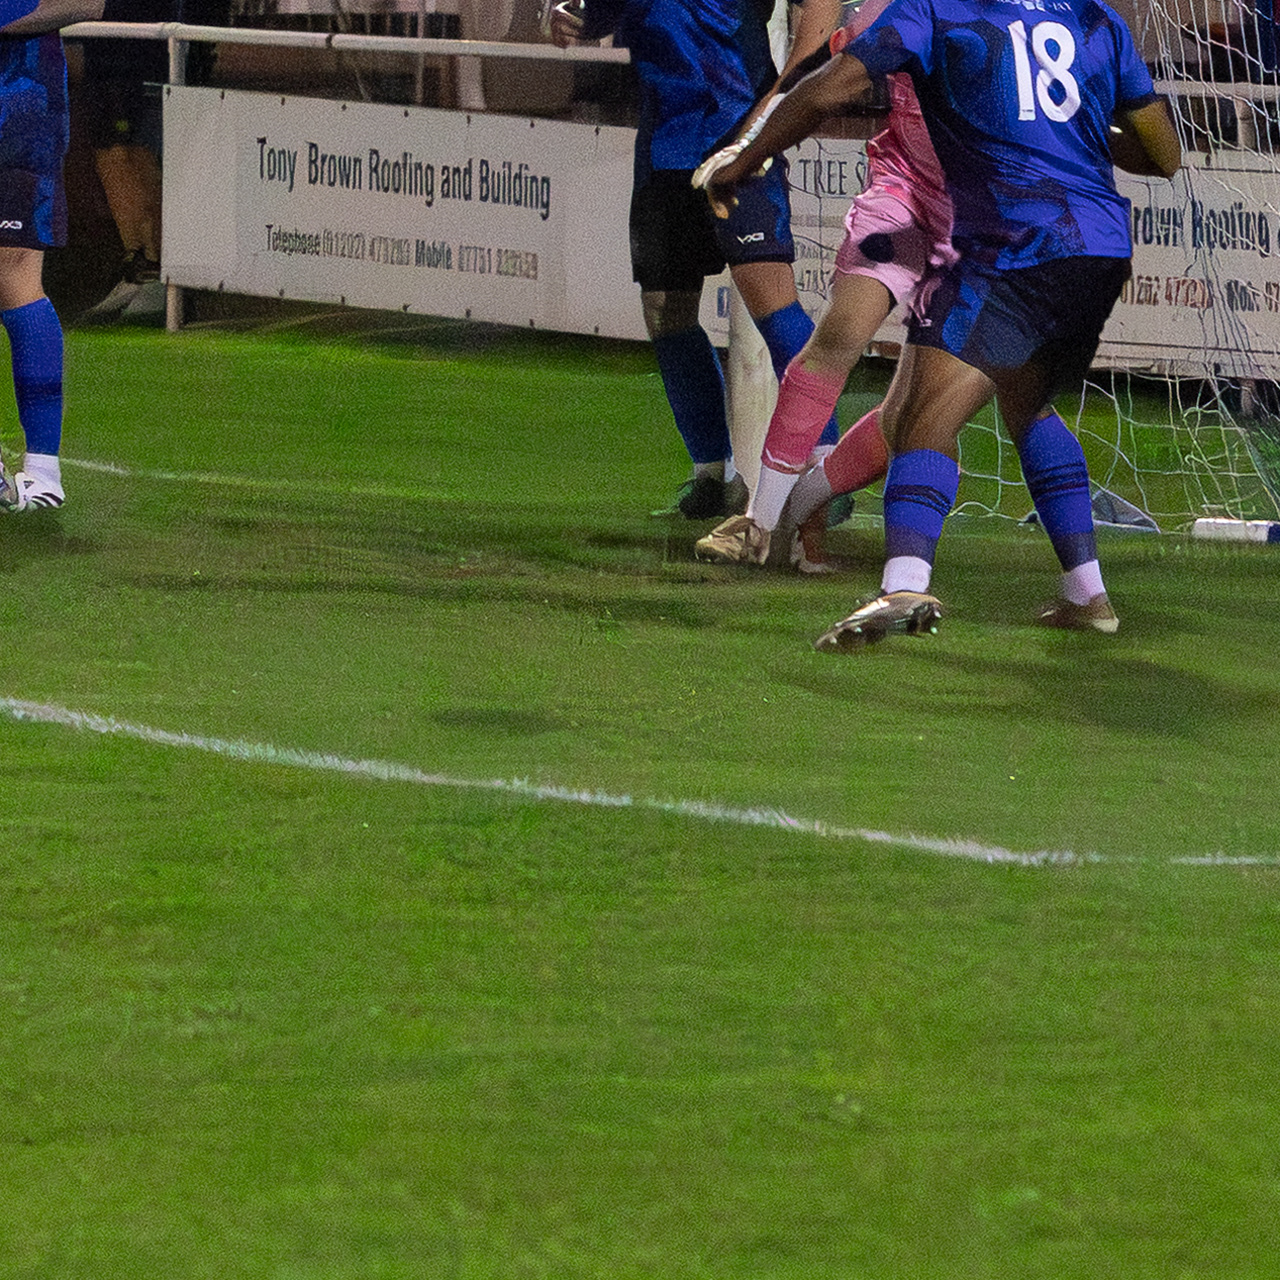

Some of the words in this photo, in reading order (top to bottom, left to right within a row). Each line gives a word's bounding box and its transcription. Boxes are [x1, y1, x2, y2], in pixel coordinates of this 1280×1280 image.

[1007, 19, 1081, 123] 18
[256, 137, 297, 193] Tony
[306, 141, 363, 191] Brown
[369, 148, 434, 208] Roofing
[440, 158, 473, 202] and
[479, 158, 551, 221] Building
[799, 159, 847, 196] TREE
[1133, 206, 1183, 247] rown
